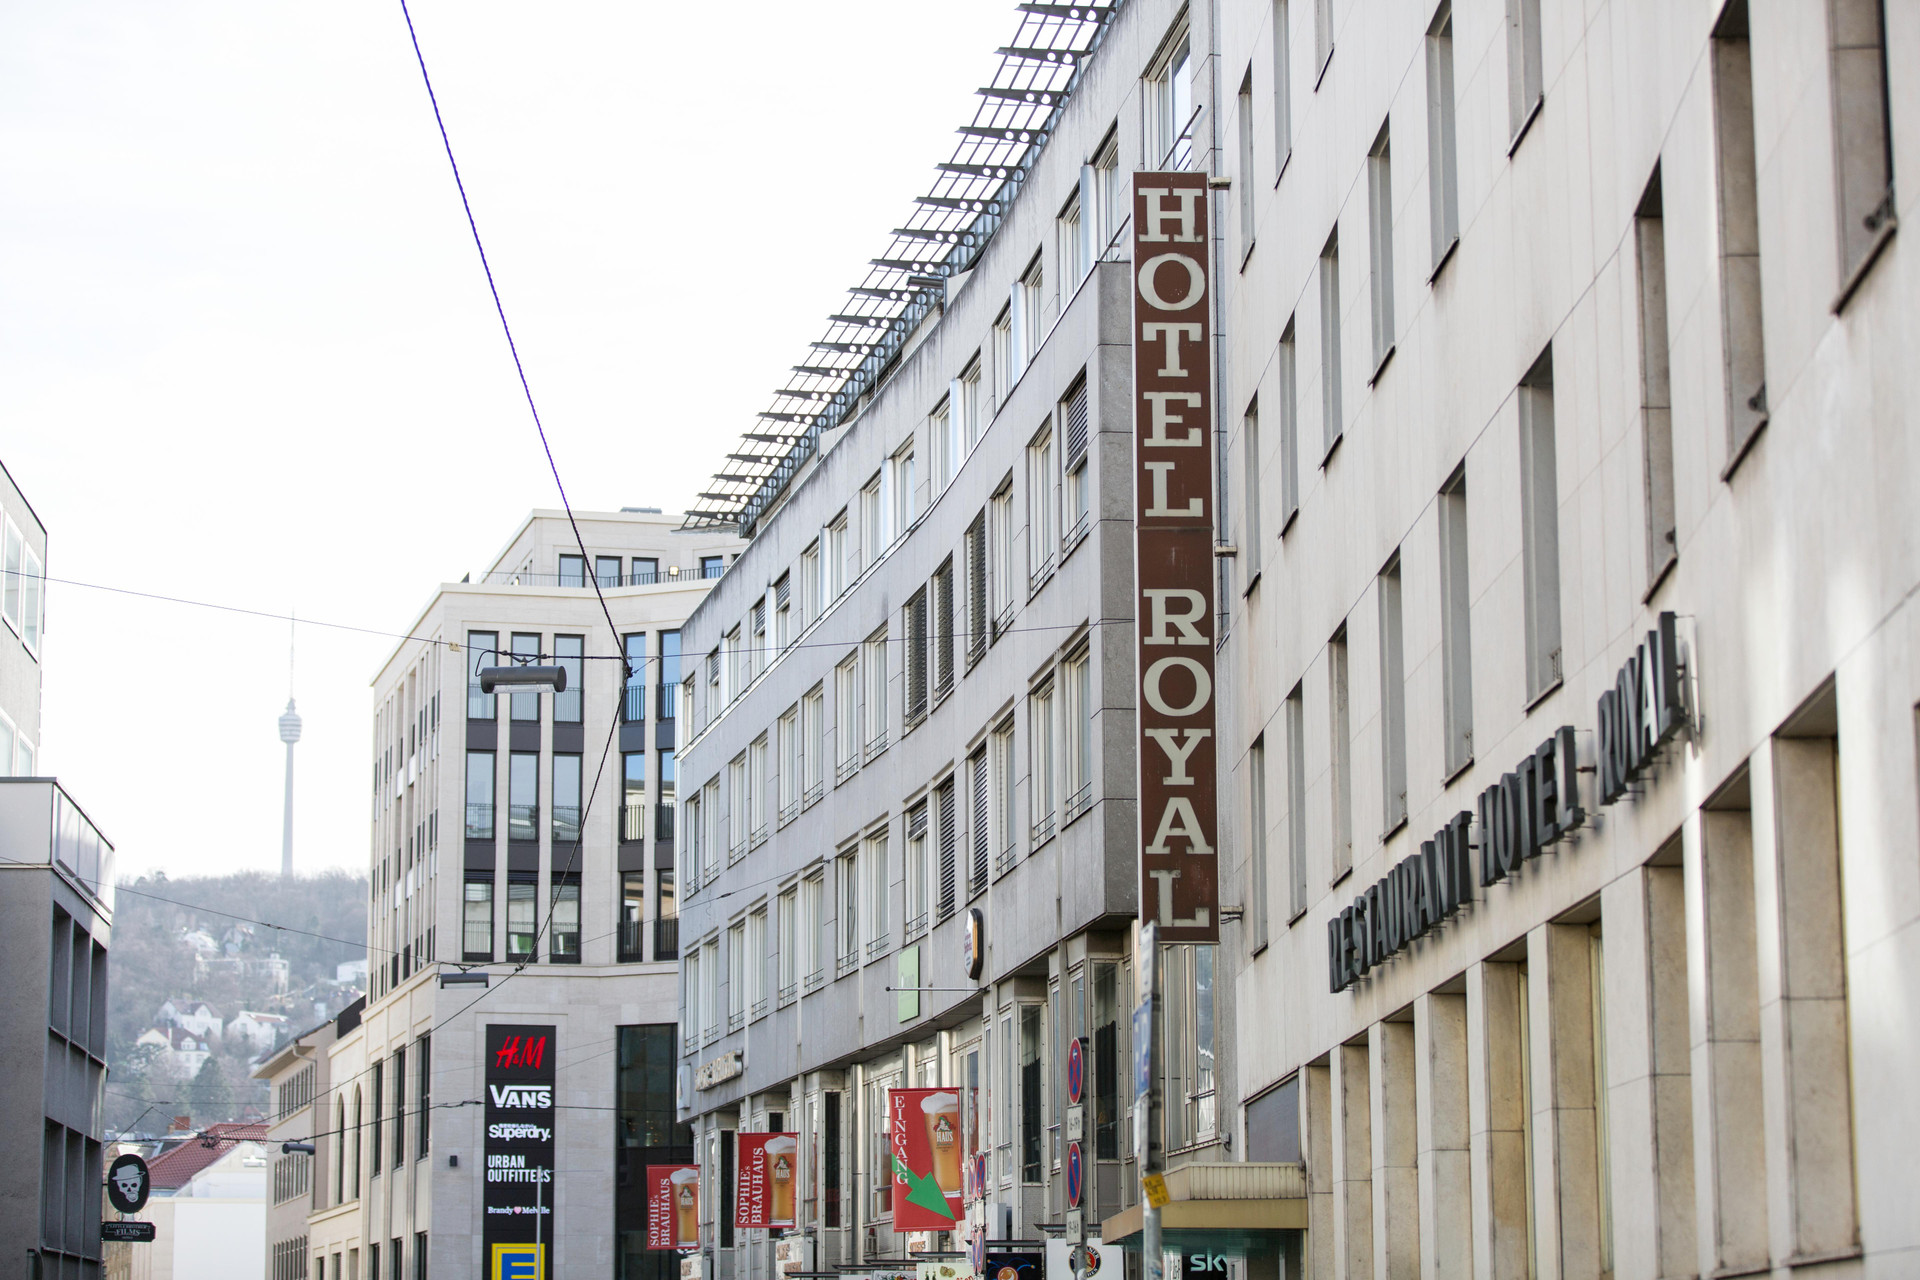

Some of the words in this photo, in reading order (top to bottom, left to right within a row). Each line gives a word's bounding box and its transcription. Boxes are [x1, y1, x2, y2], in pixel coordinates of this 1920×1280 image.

[1137, 187, 1206, 518] HOTEL
[1142, 588, 1215, 928] ROYAL
[1328, 811, 1472, 993] RESTAURANT
[1478, 725, 1585, 888] HOTEL
[1598, 611, 1686, 806] ROYAL
[496, 1035, 547, 1070] H&M
[487, 1154, 526, 1169] URBAN
[894, 1095, 909, 1185] EINGANG
[487, 1205, 514, 1216] Brandy
[521, 1205, 551, 1215] Melvlle
[660, 1178, 671, 1246] BRAUHAUS
[751, 1147, 764, 1224] BRAUHAUS
[113, 1228, 141, 1236] FILMS
